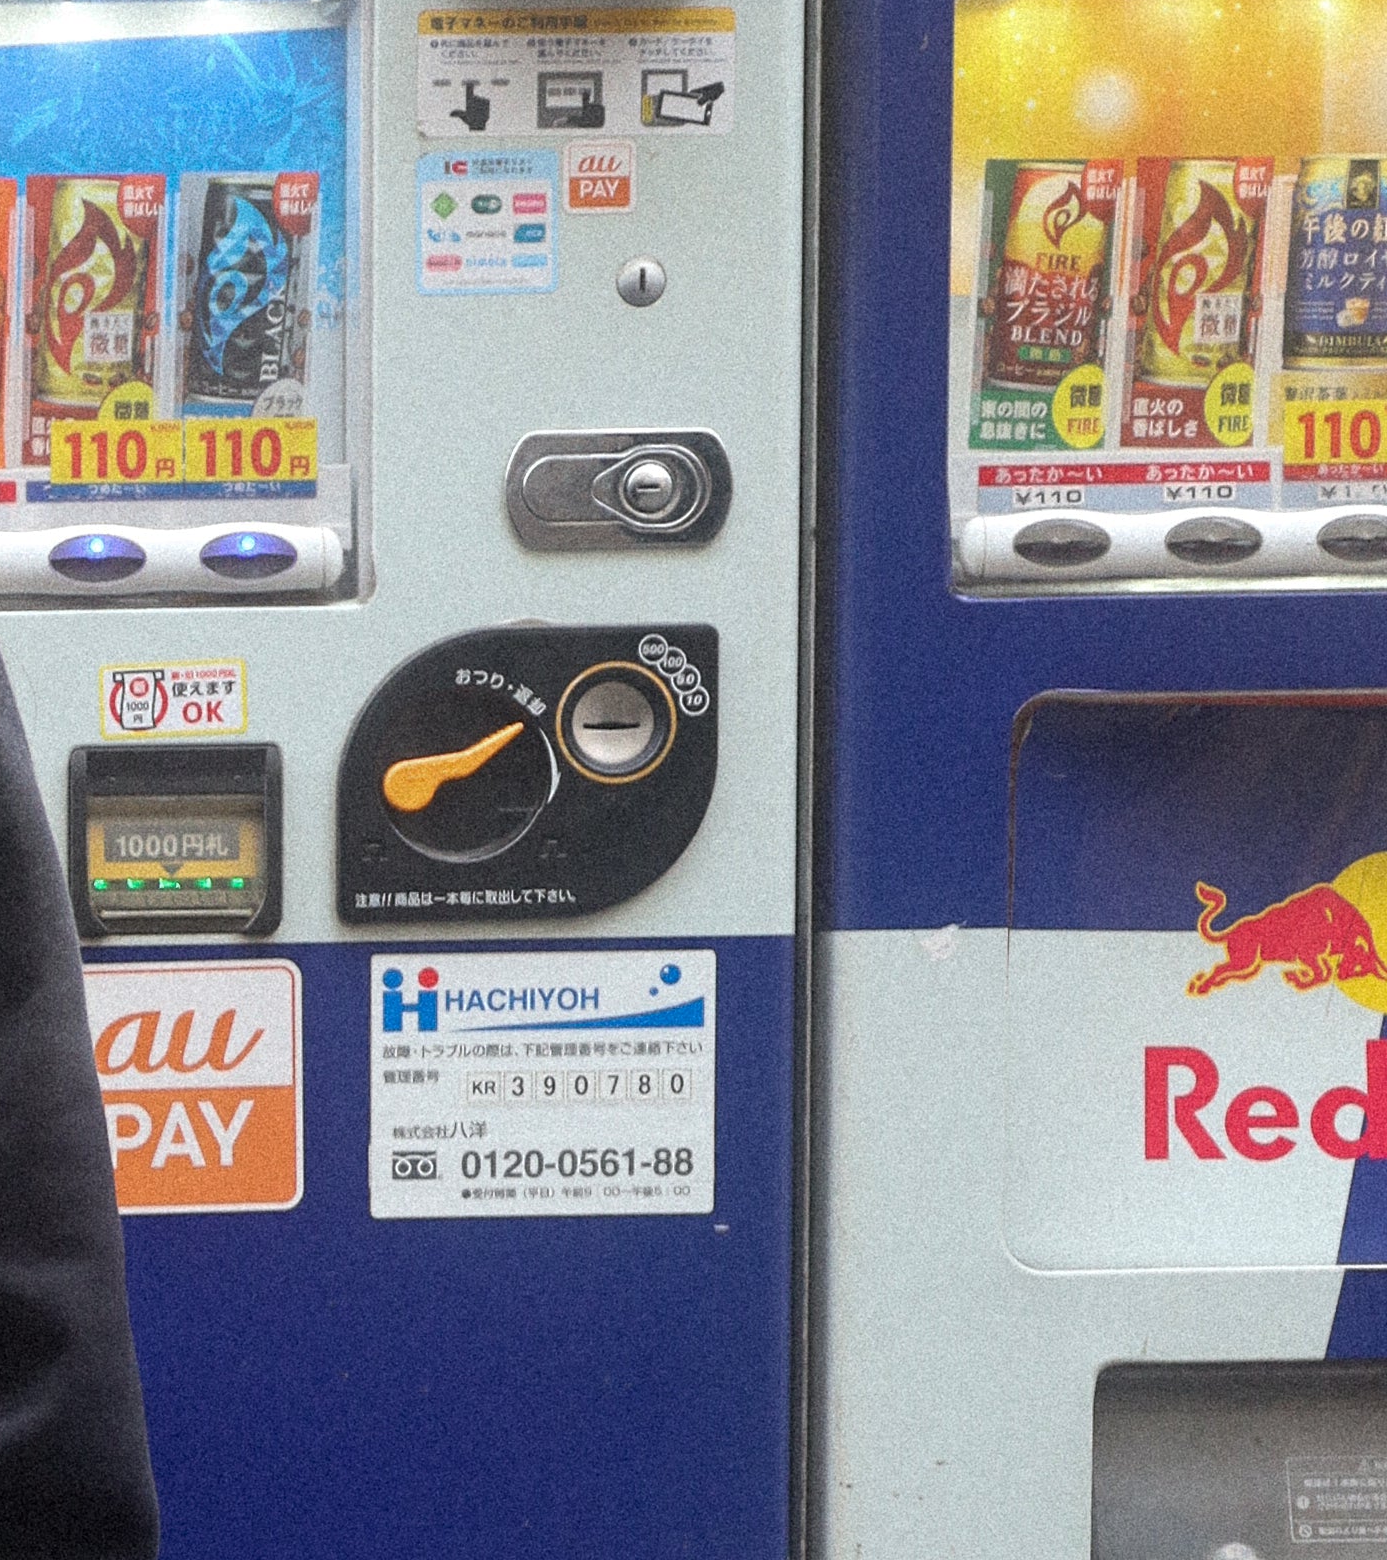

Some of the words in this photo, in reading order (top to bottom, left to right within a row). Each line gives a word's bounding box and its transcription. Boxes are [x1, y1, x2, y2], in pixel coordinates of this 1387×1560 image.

[577, 154, 623, 174] au
[578, 179, 620, 200] PAY
[1036, 252, 1082, 273] FIRE
[1005, 265, 1101, 301] 満たされる
[1005, 298, 1093, 326] ブラジル
[258, 285, 290, 383] BLACK
[1010, 325, 1086, 348] BLEND
[1131, 398, 1185, 416] 直火の
[1066, 415, 1100, 436] FIRE
[1131, 419, 1198, 439] 香ばしさ
[1217, 414, 1250, 434] FIRE
[1297, 409, 1383, 461] 110
[62, 429, 177, 481] 110円
[198, 428, 313, 479] 110円
[994, 467, 1104, 484] あったか〜い
[1144, 464, 1255, 481] あったか〜い
[1015, 489, 1083, 506] ¥110
[1167, 485, 1234, 501] ¥110
[170, 678, 238, 698] 使えます
[180, 698, 226, 726] OK
[114, 830, 229, 859] 1000円札
[354, 891, 393, 910] 注意!!
[444, 986, 601, 1013] HACHIYOH
[93, 1008, 266, 1077] au
[471, 1081, 497, 1095] KR
[511, 1075, 525, 1097] 3
[542, 1075, 558, 1096] 9
[573, 1074, 590, 1096] 0
[606, 1074, 621, 1095] 7
[638, 1073, 653, 1095] 8
[669, 1072, 685, 1094] 0
[1144, 1038, 1387, 1161] Red
[107, 1098, 256, 1171] PAY
[391, 1121, 489, 1141] 株式会社八洋
[460, 1147, 696, 1181] 0120-0561-88
